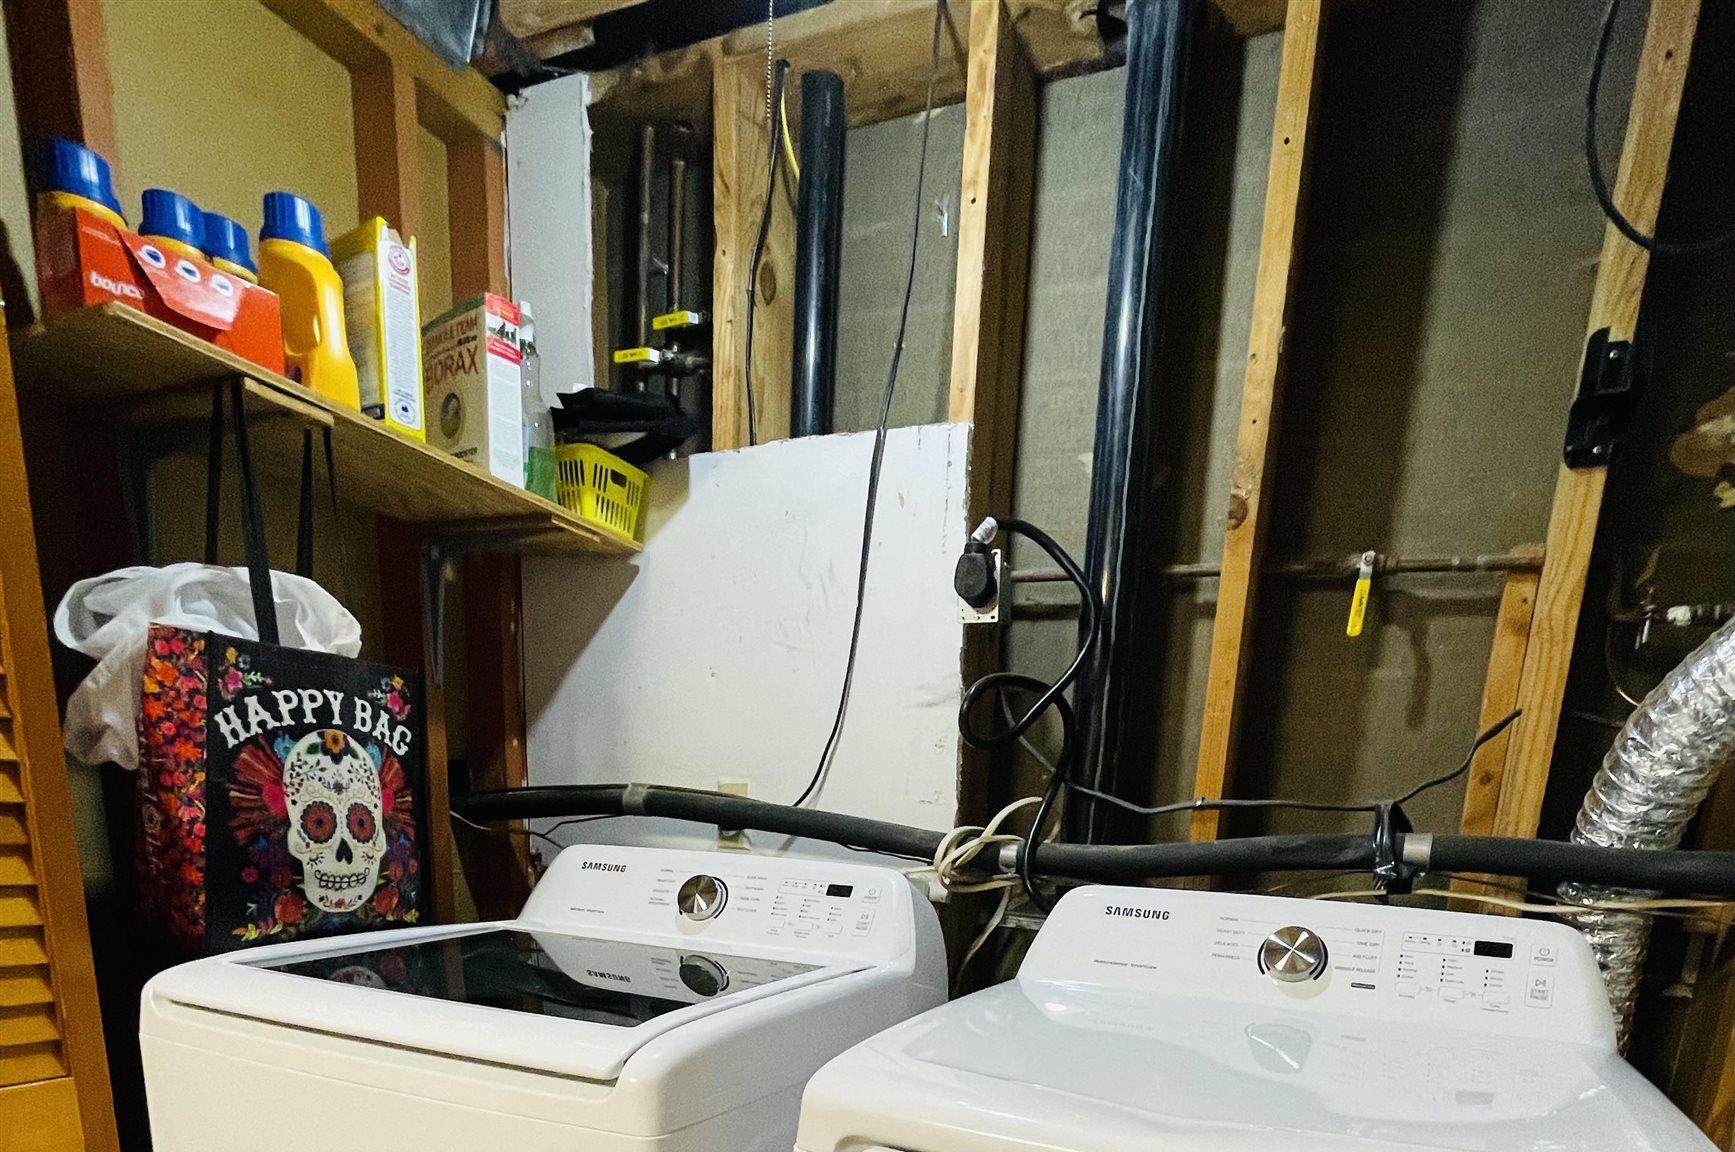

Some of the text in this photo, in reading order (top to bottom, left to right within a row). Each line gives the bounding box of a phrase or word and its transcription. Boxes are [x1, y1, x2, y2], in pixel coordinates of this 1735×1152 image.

[424, 345, 479, 394] BORAX
[213, 688, 412, 756] HAPPY BAG
[581, 861, 627, 873] SAMSUNG
[1105, 905, 1171, 921] SAMSUNG
